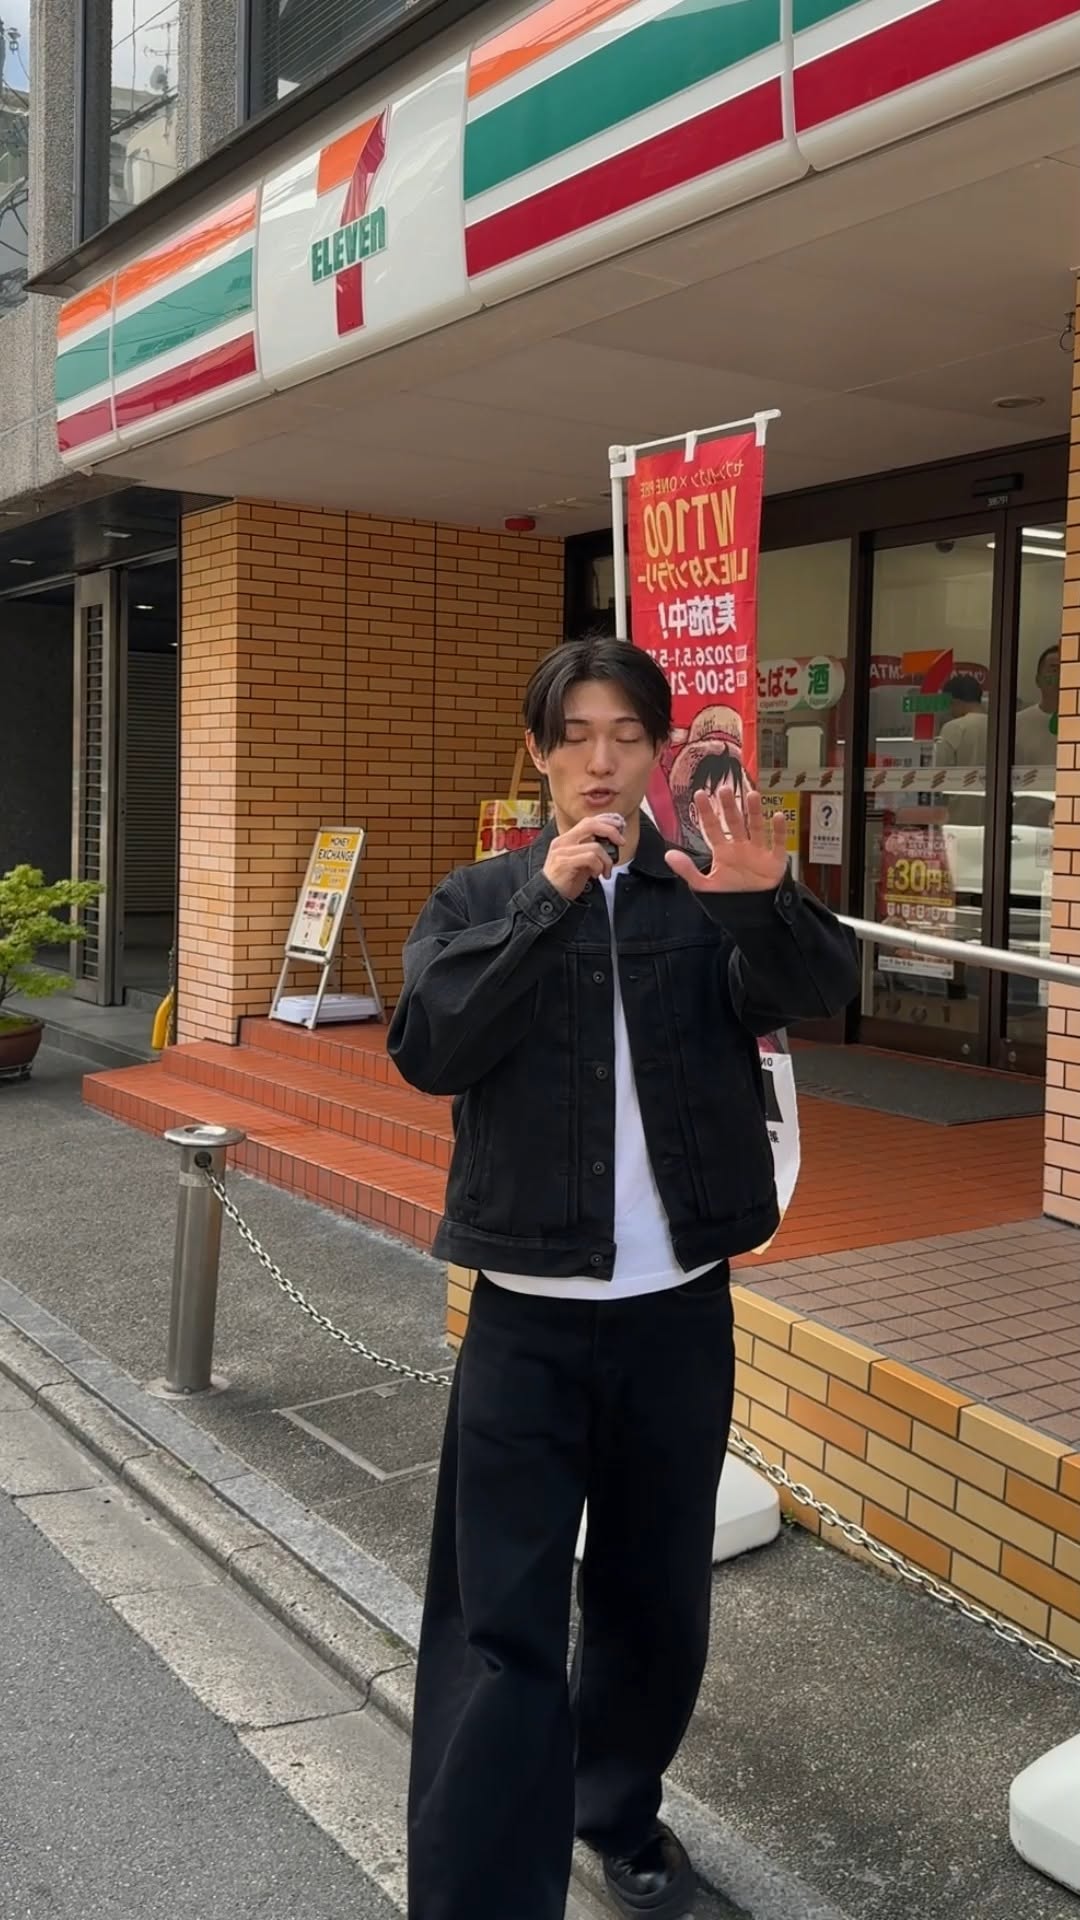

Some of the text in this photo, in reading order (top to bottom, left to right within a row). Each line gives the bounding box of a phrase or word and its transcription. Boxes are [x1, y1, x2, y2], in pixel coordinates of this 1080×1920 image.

[808, 663, 830, 695] 酒
[869, 663, 900, 681] ATM
[756, 665, 798, 698] たばこ
[761, 795, 784, 806] ONEY
[331, 837, 350, 847] MONEY
[318, 848, 355, 862] EXCHANGE
